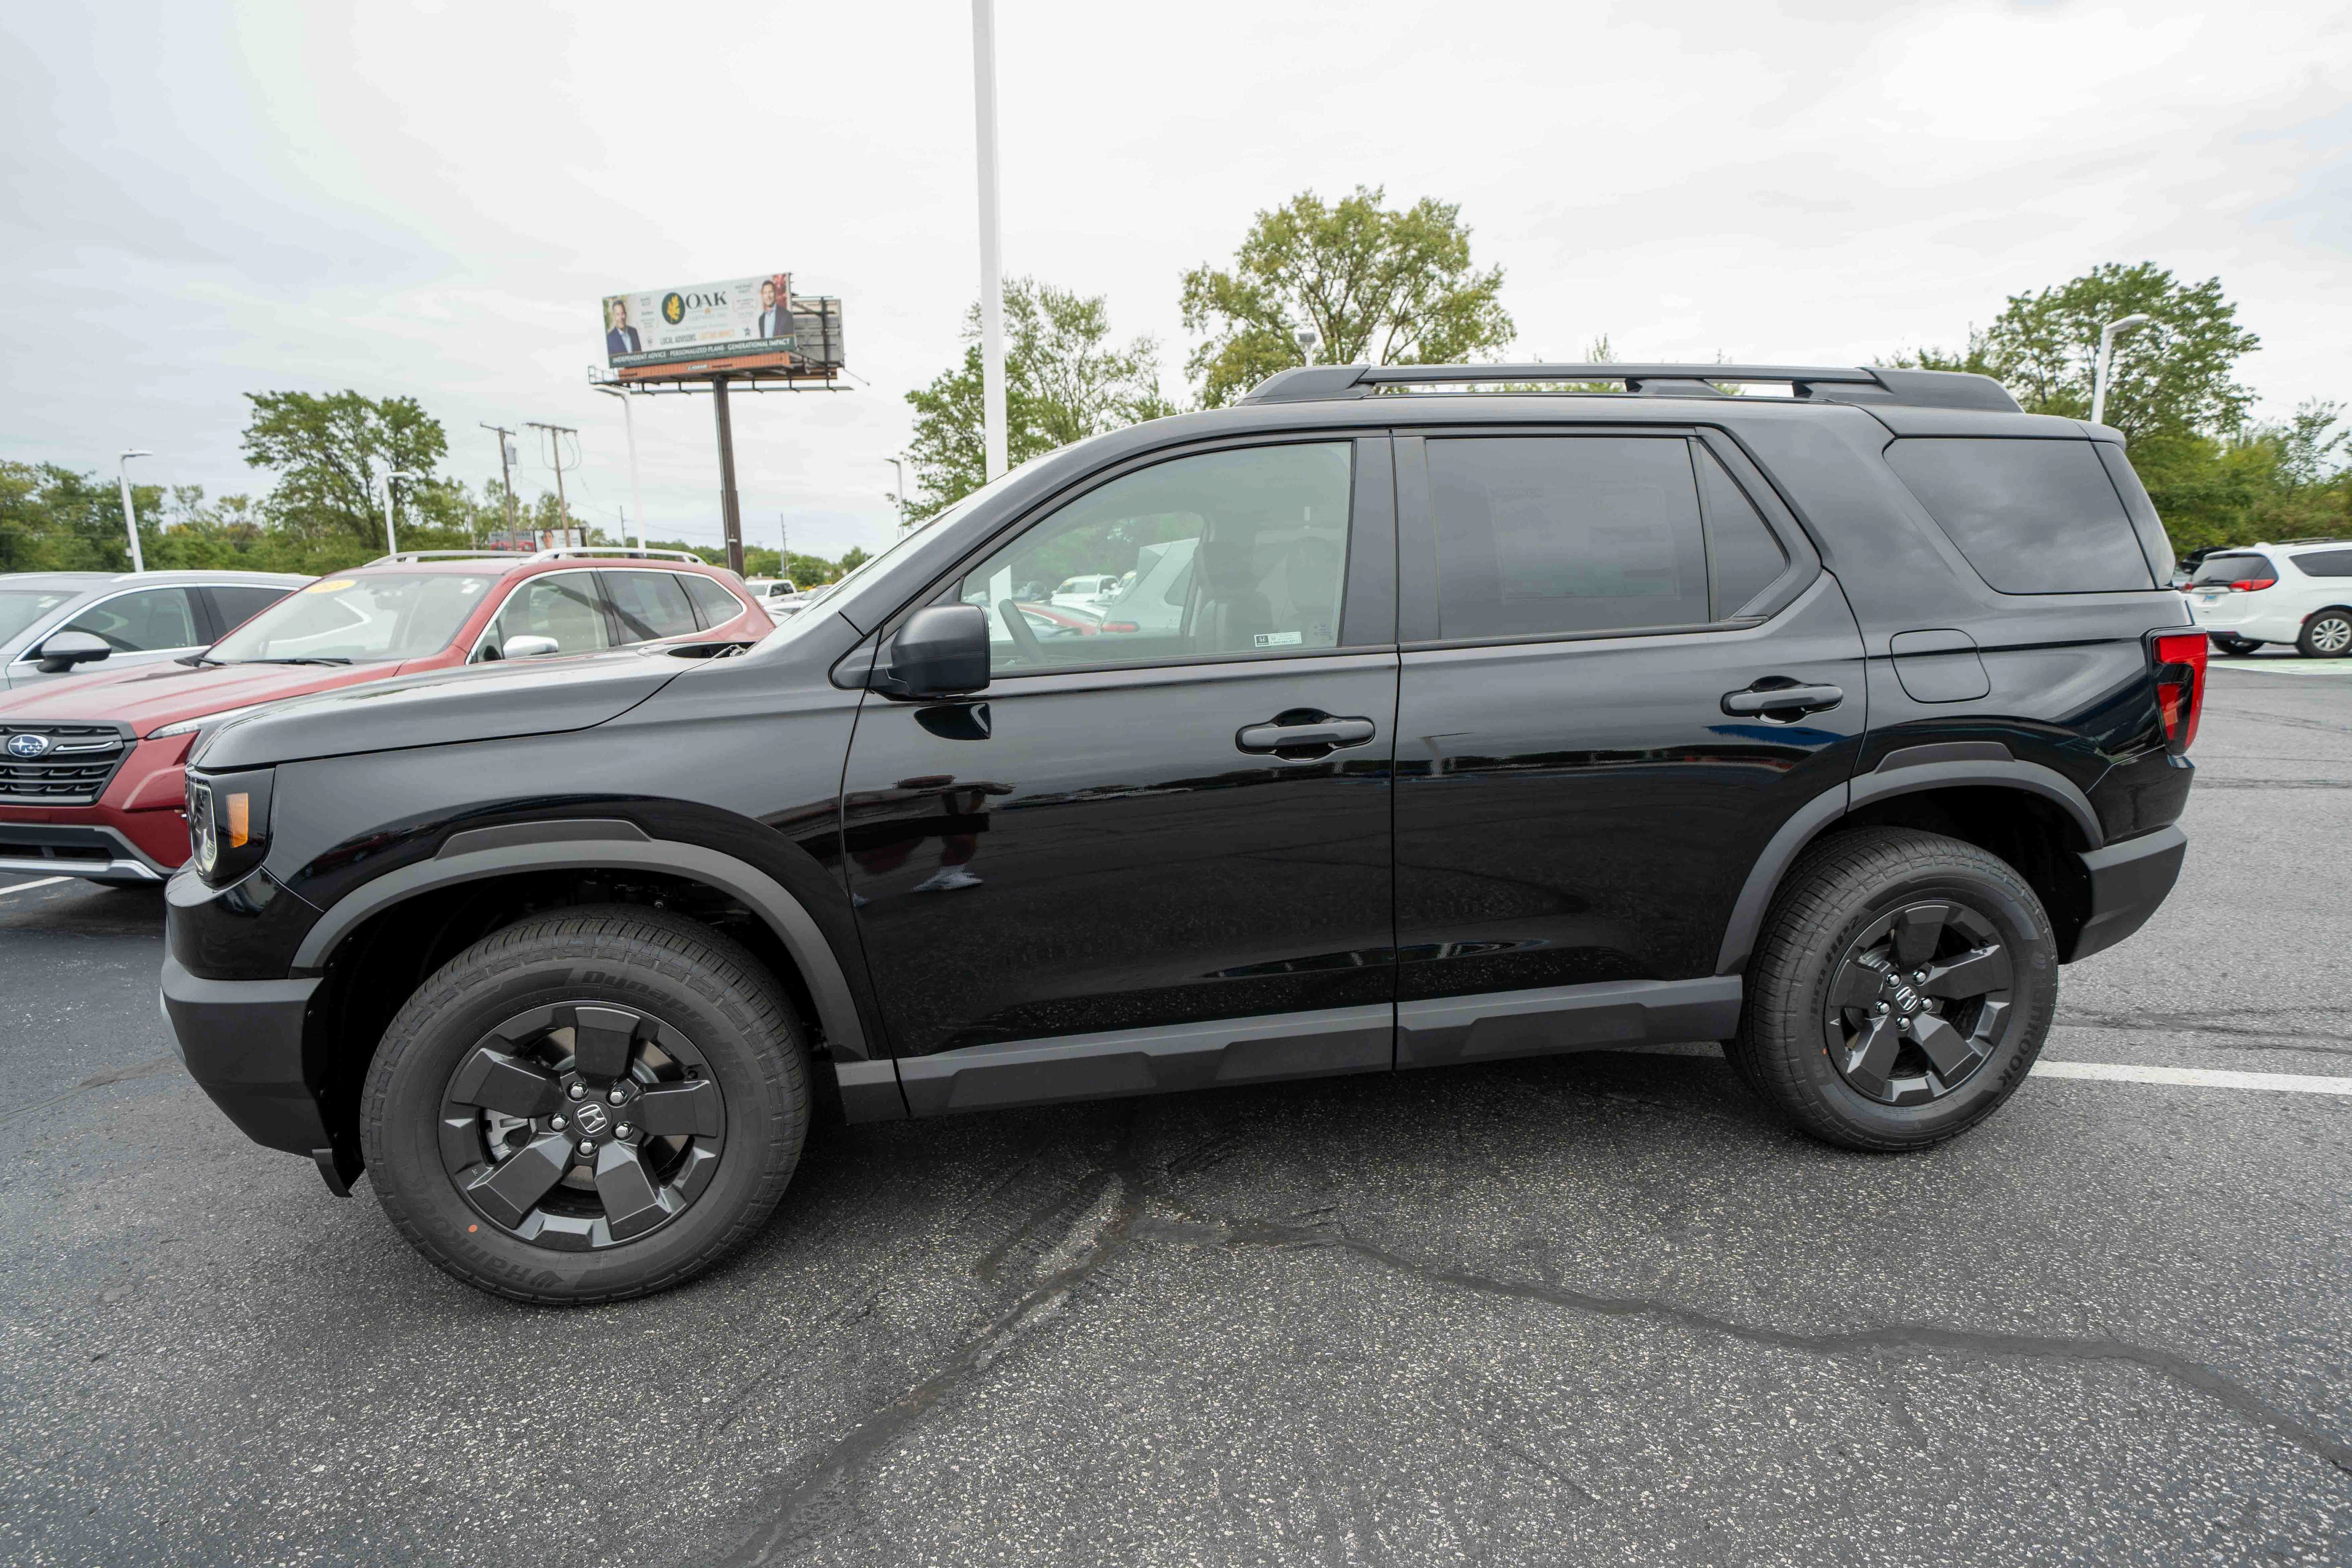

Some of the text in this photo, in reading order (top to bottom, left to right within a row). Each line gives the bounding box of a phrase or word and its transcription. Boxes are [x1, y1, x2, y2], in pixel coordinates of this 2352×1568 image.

[686, 291, 727, 309] OAK
[708, 344, 724, 353] PLANS
[727, 339, 768, 350] GENERATIONAL
[768, 337, 791, 347] IMPACT
